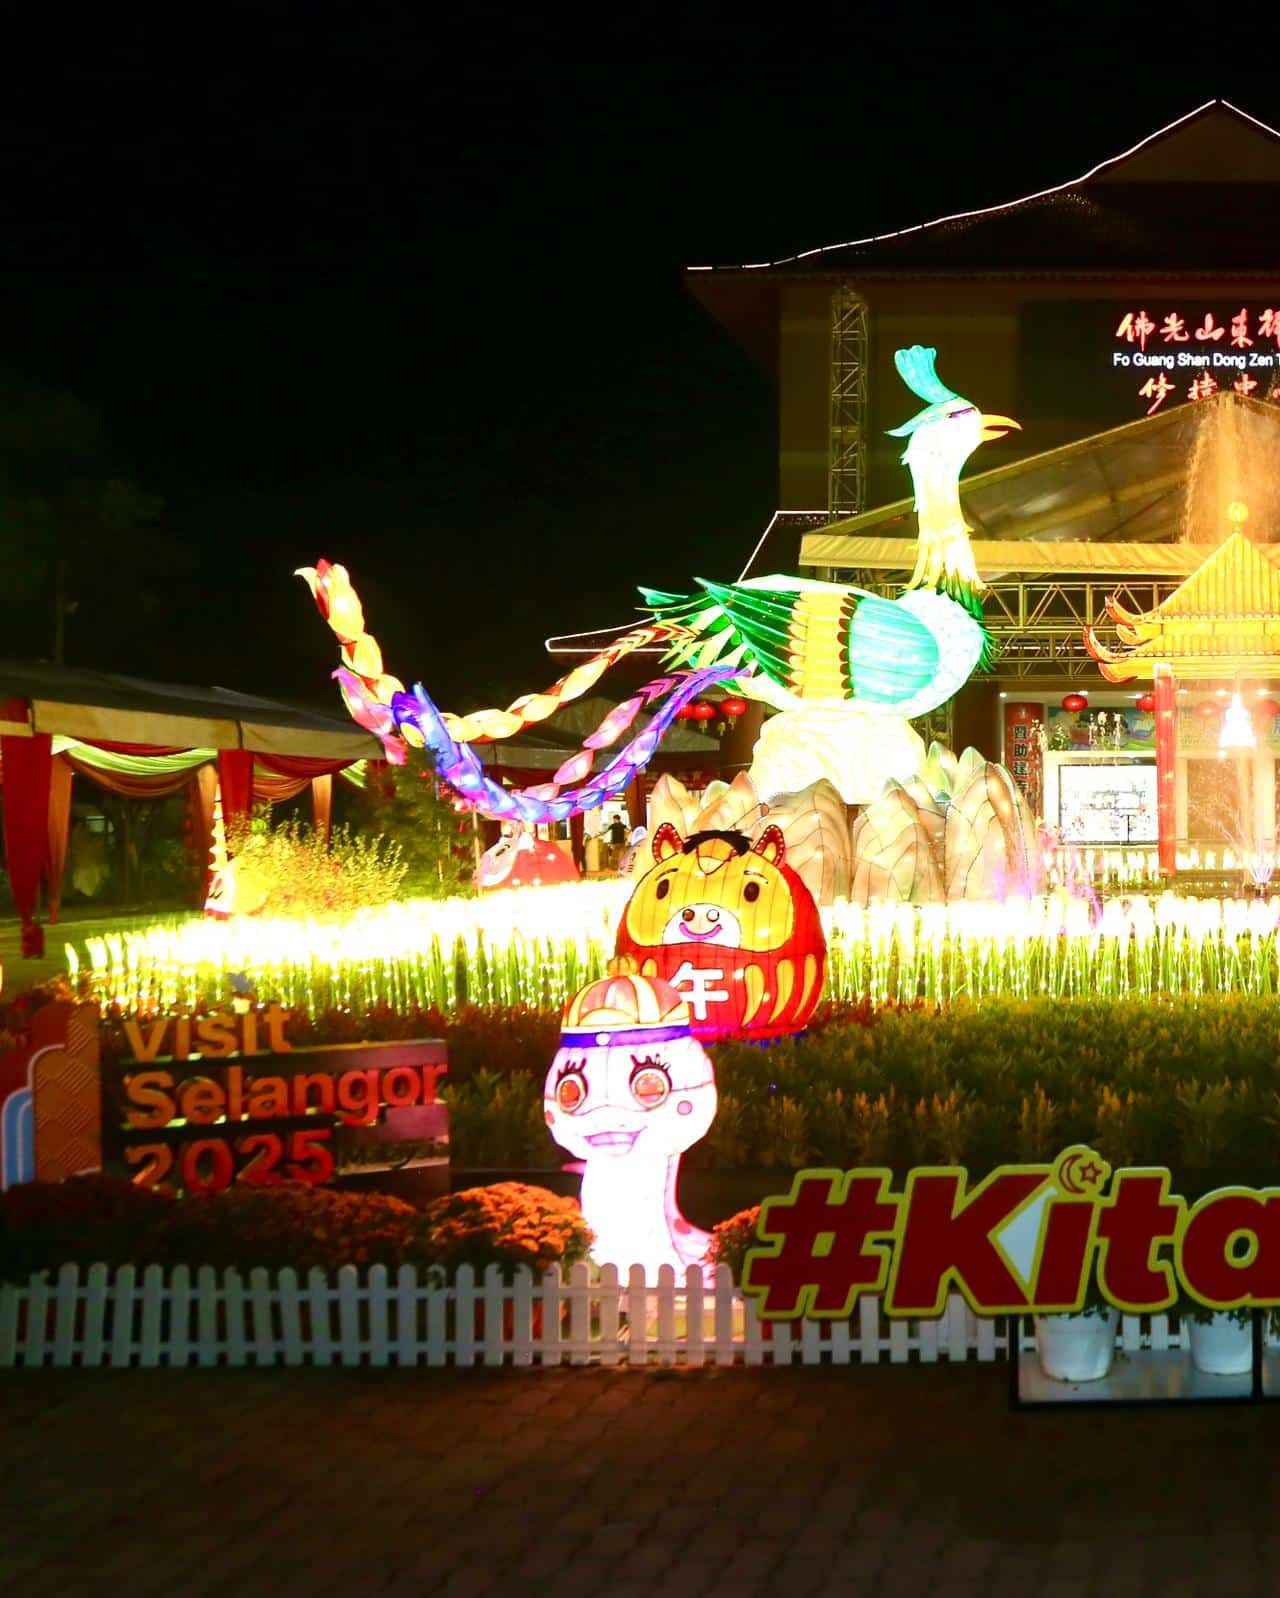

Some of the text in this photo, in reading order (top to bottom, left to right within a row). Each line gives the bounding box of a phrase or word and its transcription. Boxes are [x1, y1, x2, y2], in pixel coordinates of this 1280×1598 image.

[1113, 352, 1131, 367] Fo
[1132, 352, 1175, 370] Guang
[1177, 352, 1210, 367] Shan
[1213, 352, 1246, 370] Dong
[1248, 352, 1273, 367] Zen
[668, 961, 730, 1021] 午
[124, 1064, 448, 1129] Selangor
[126, 1128, 336, 1193] 2025
